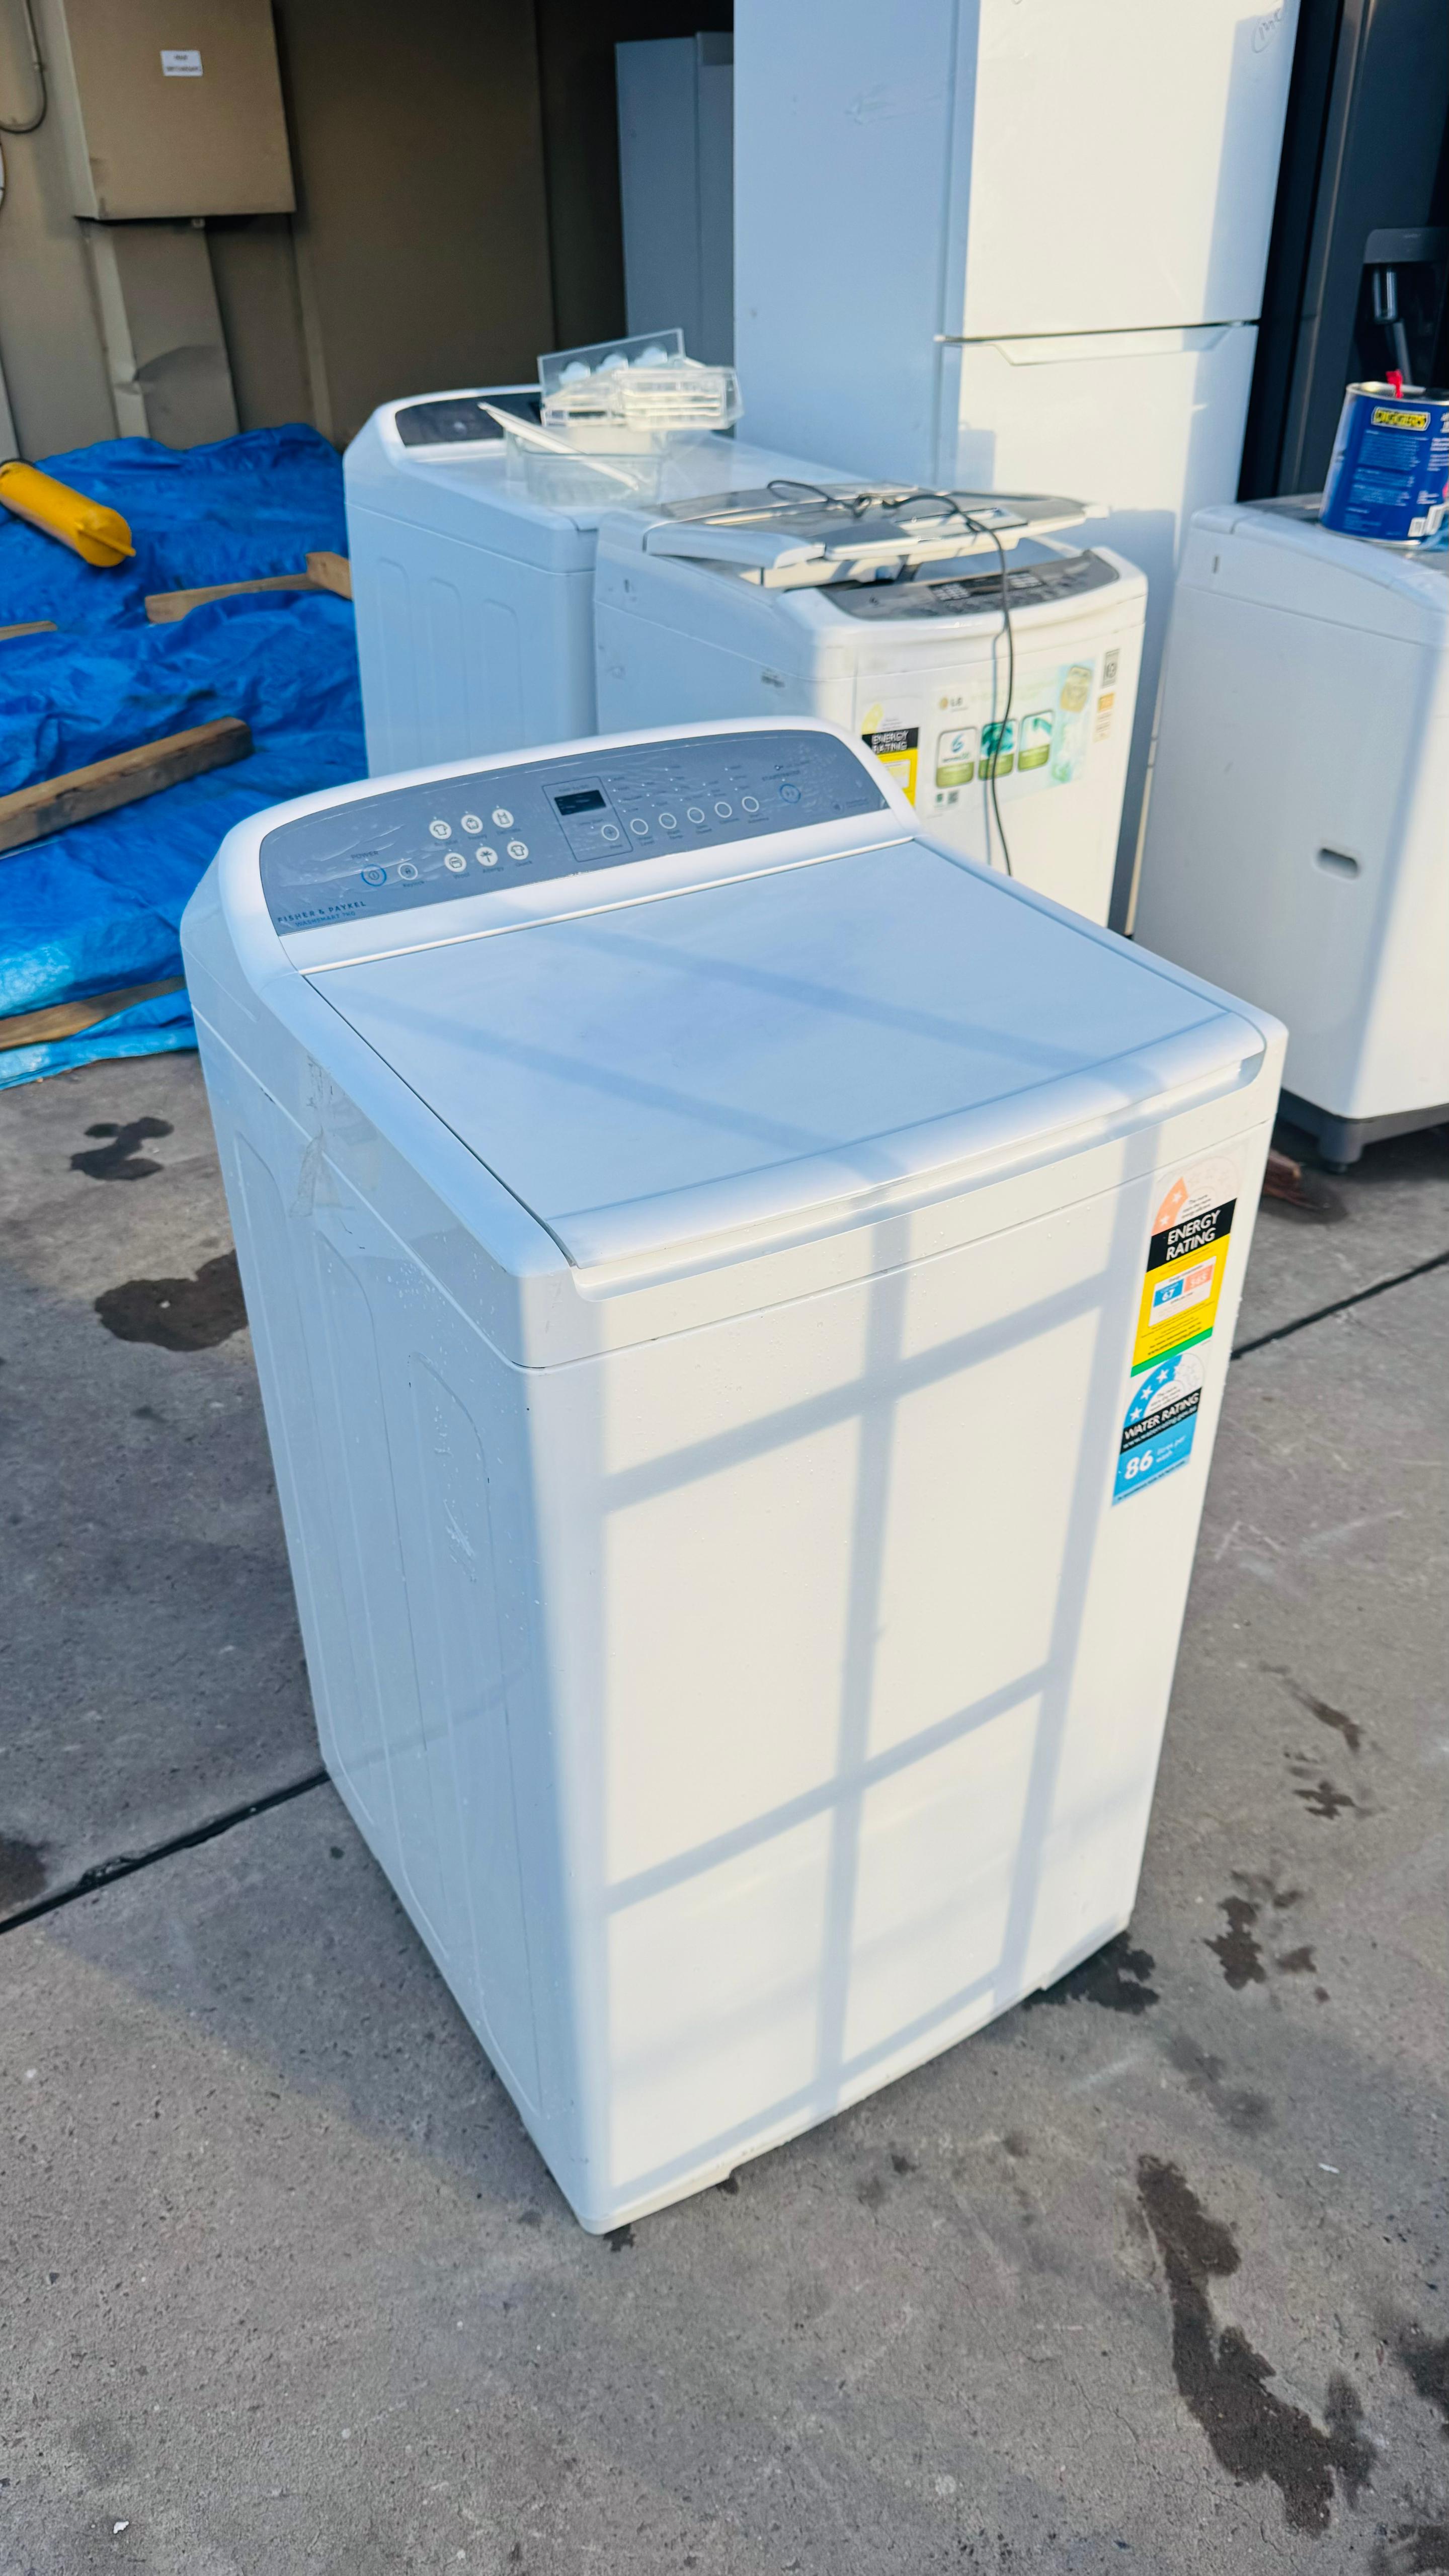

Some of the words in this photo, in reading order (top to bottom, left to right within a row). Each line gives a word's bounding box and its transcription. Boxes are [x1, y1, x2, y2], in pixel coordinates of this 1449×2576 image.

[278, 911, 315, 923] FISHER
[329, 901, 366, 913] PAYKEL
[1168, 1210, 1221, 1245] ENERGY
[1166, 1227, 1217, 1261] RATING
[1162, 1288, 1175, 1302] 67
[1124, 1415, 1160, 1440] WATER
[1161, 1392, 1200, 1421] RATING
[1124, 1450, 1154, 1480] 86
